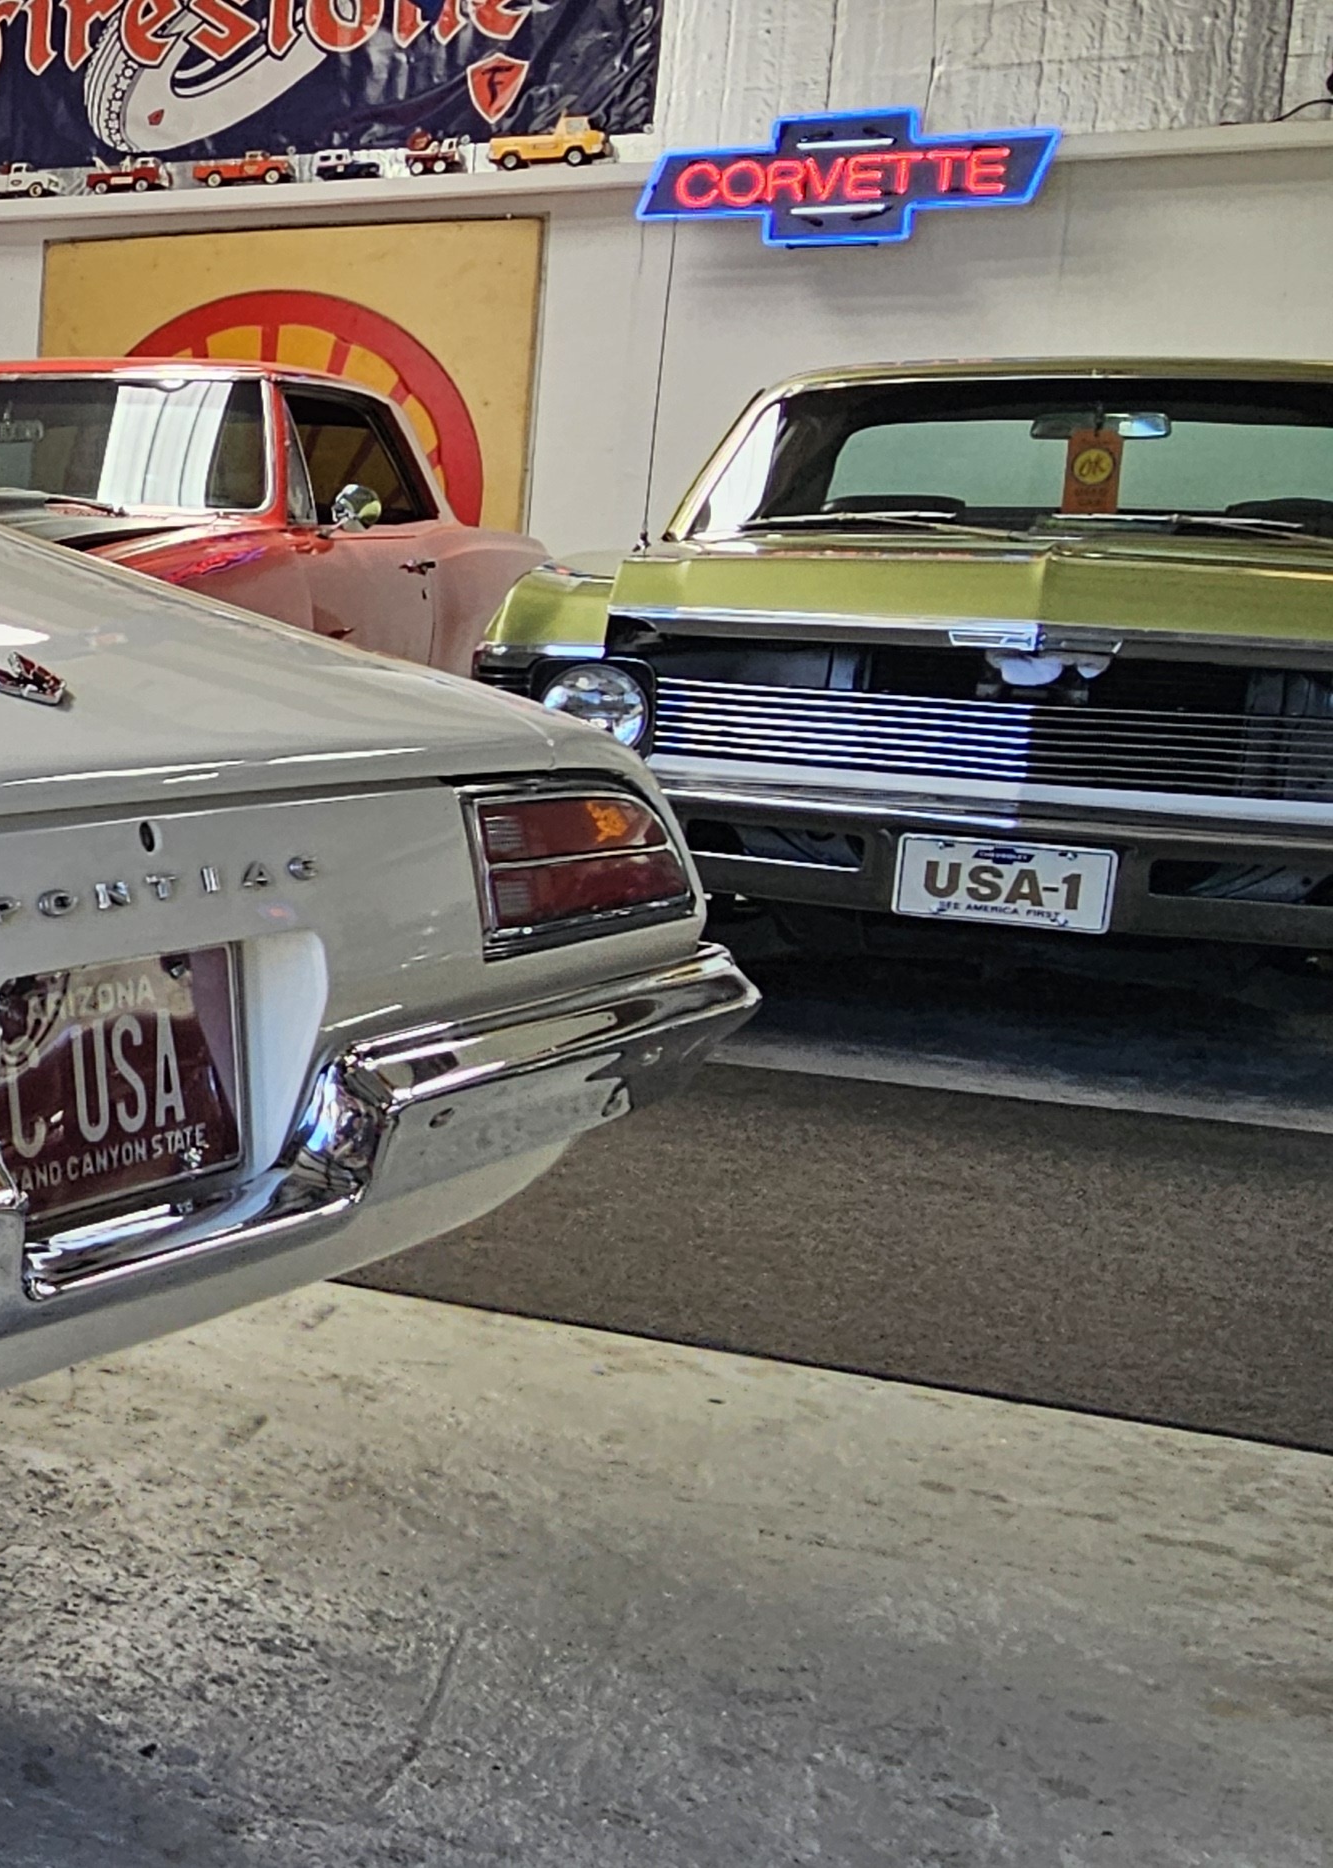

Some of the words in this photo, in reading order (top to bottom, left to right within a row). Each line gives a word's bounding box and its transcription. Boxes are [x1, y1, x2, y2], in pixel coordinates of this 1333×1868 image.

[675, 147, 1011, 208] CORVETTE
[923, 860, 1083, 911] USA-1
[965, 903, 1020, 916] AMERICA
[1026, 909, 1063, 922] FIRST
[70, 1008, 187, 1142] USA
[20, 1162, 62, 1191] AND
[66, 1138, 148, 1180] CANYON
[151, 1121, 207, 1159] STATE
